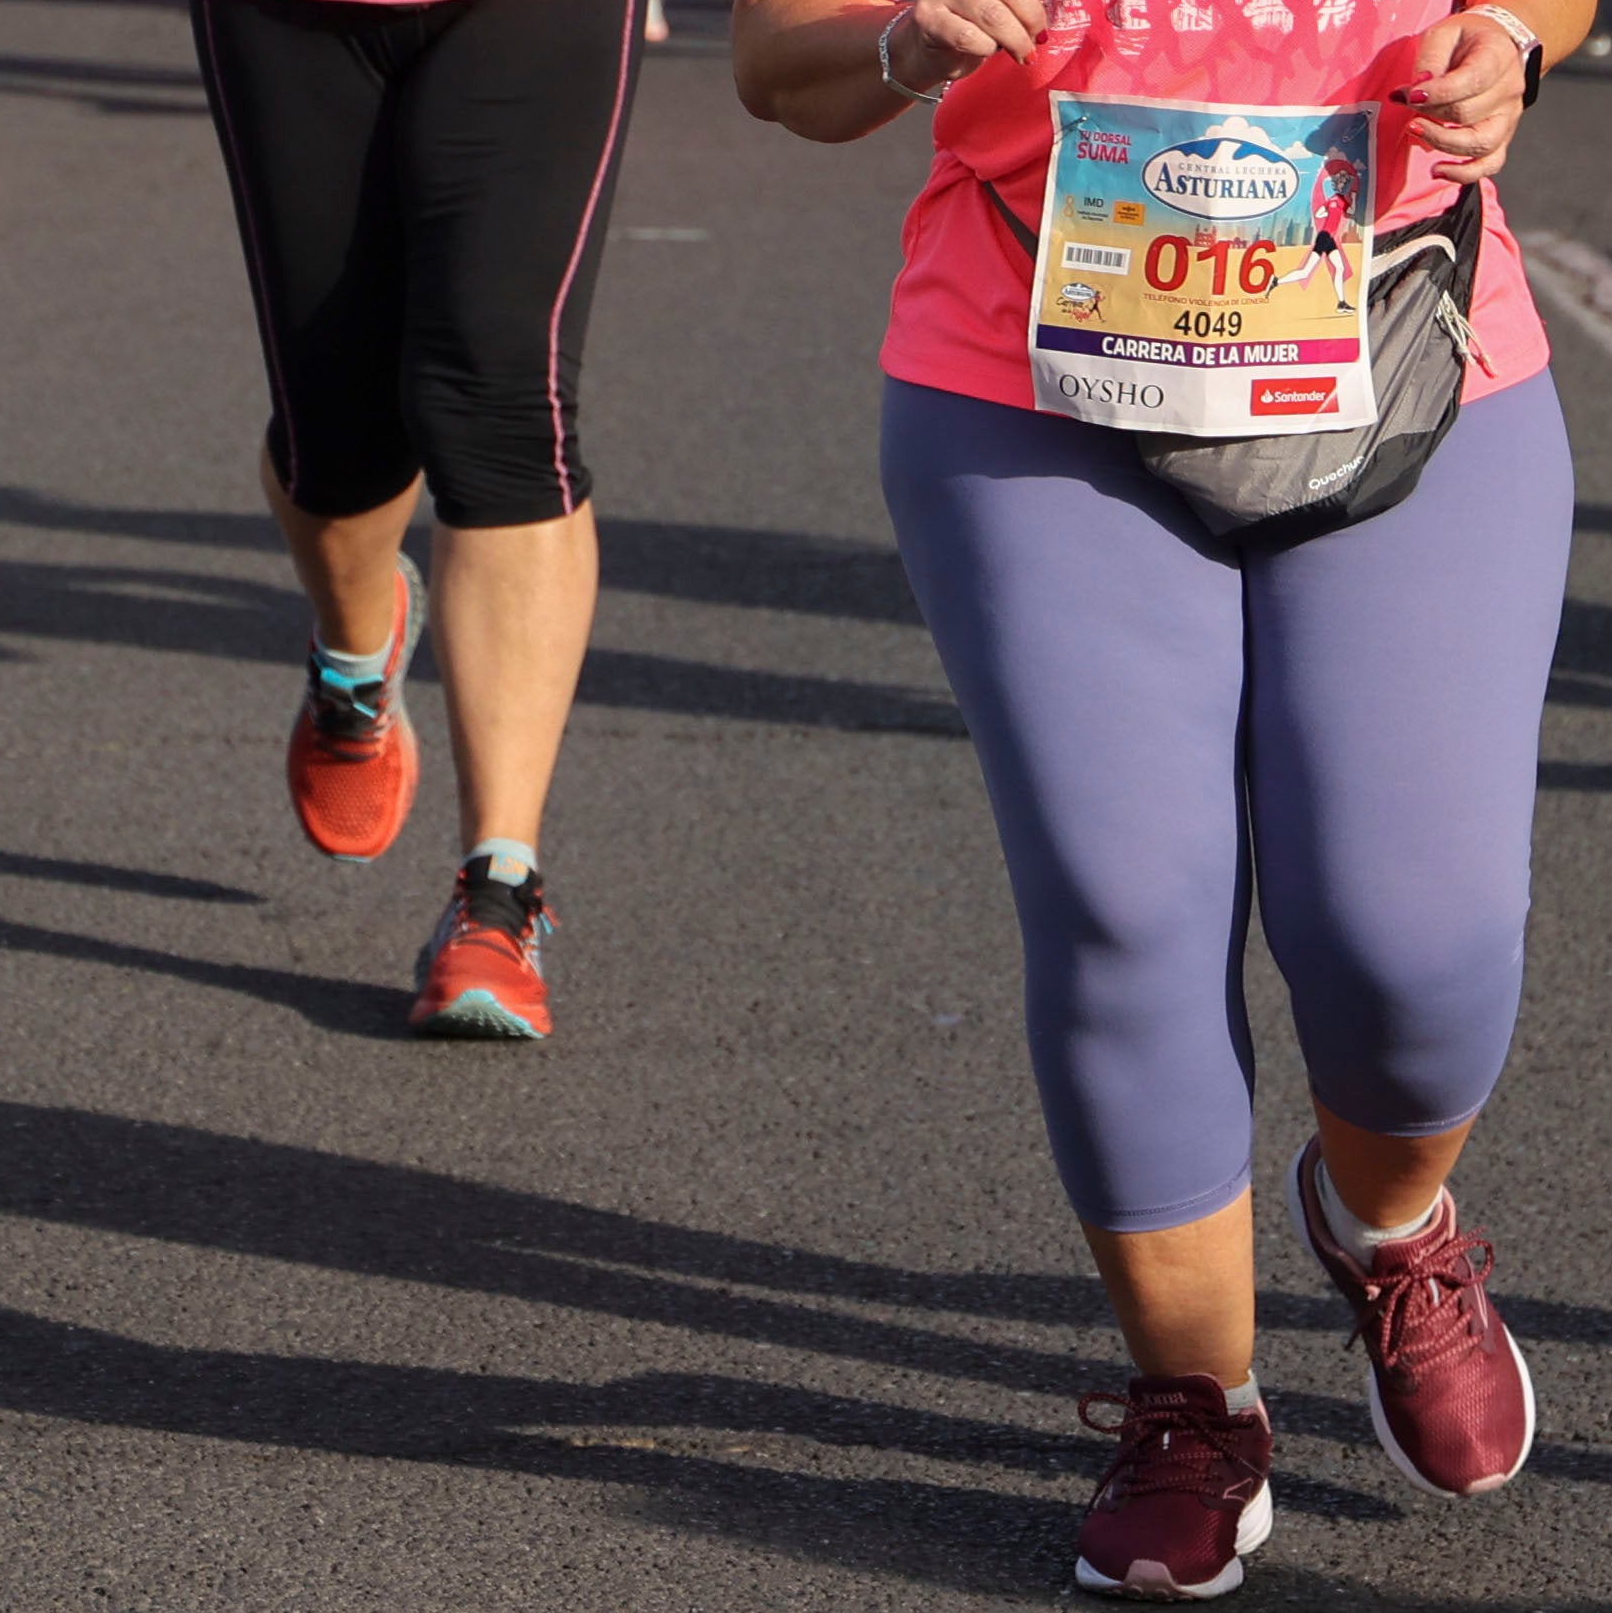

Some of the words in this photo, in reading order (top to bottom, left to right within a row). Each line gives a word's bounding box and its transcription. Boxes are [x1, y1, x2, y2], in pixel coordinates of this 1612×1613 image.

[1076, 140, 1129, 165] SUMA
[1093, 131, 1132, 147] DORSAL
[1153, 161, 1288, 200] ASTURIANA
[1178, 162, 1231, 175] CENTRAL
[1234, 166, 1287, 176] LECHERA
[1083, 196, 1105, 208] IMD
[1143, 233, 1277, 296] 016
[1173, 309, 1243, 338] 4049
[1101, 336, 1186, 364] CARRERA
[1191, 345, 1216, 365] DE
[1219, 345, 1239, 365] LA
[1243, 343, 1299, 364] MUJER
[1058, 373, 1165, 410] OYSHO
[1274, 388, 1326, 404] Santander
